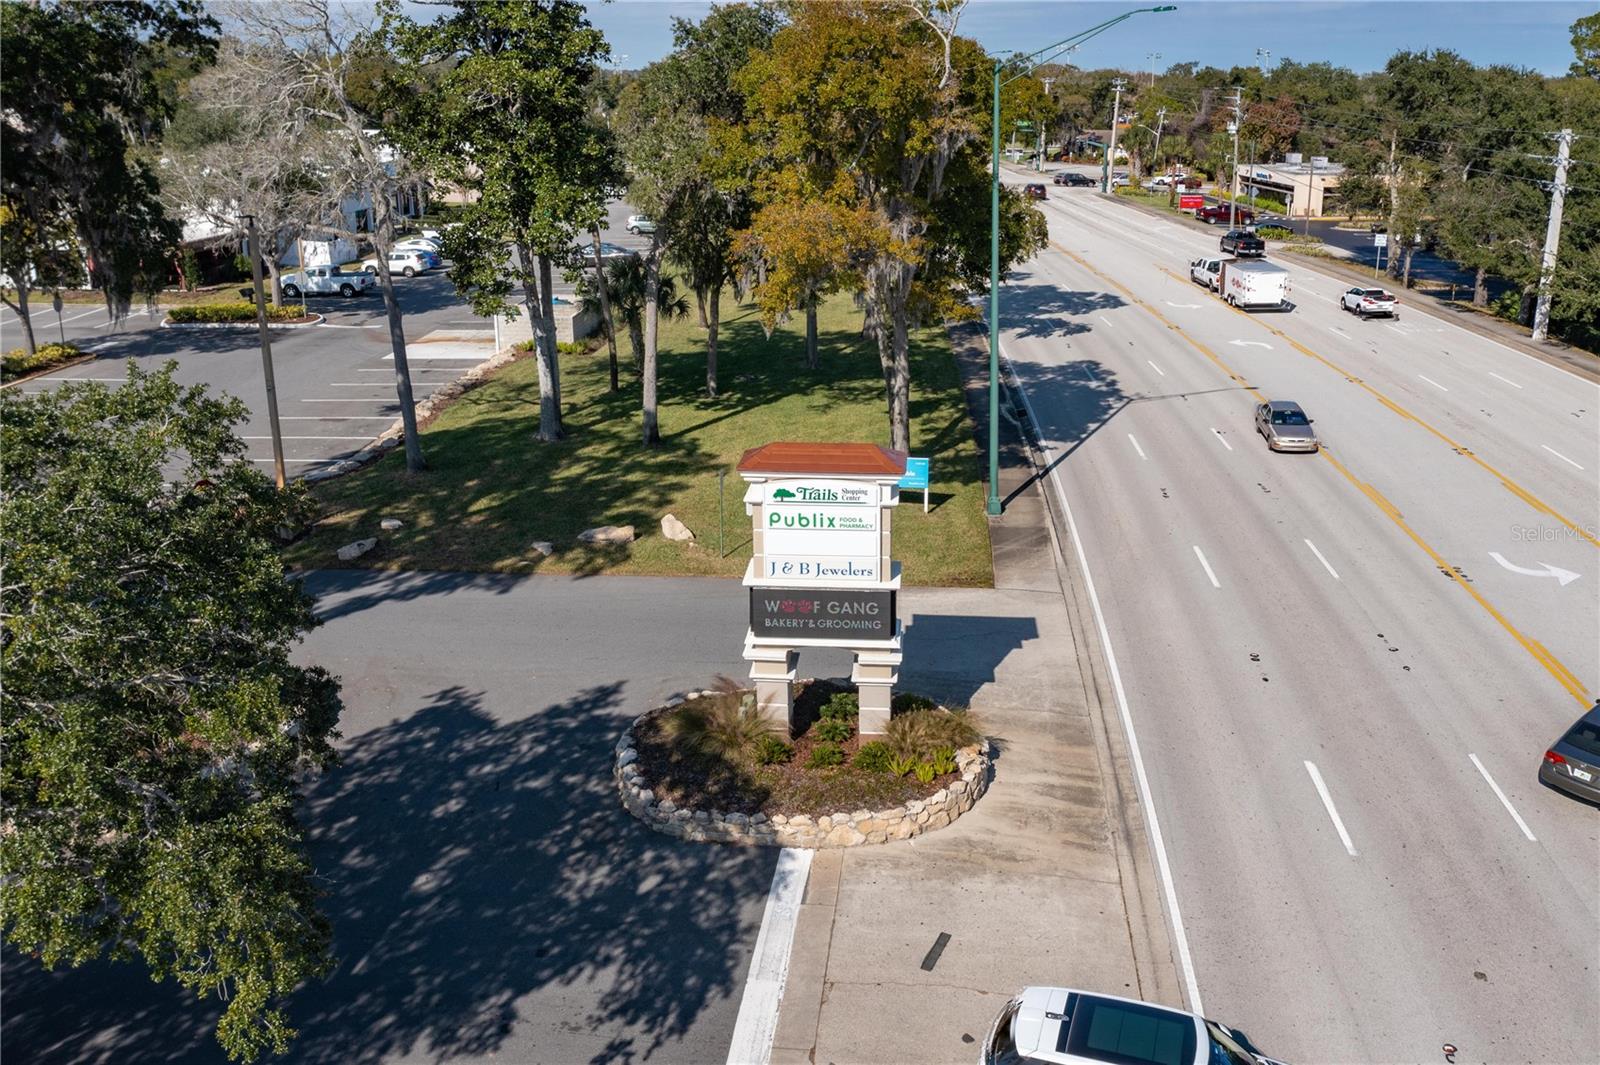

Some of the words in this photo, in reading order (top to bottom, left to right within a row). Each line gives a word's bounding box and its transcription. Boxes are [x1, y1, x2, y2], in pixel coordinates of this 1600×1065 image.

[796, 487, 838, 501] Trails
[841, 488, 868, 496] Shopping
[769, 512, 836, 528] Publix
[770, 562, 776, 576] J
[782, 562, 794, 575] &
[799, 562, 810, 575] B
[815, 561, 873, 577] Jewelers
[826, 601, 879, 615] GANG
[808, 619, 816, 628] &
[817, 619, 881, 629] GROOMING
